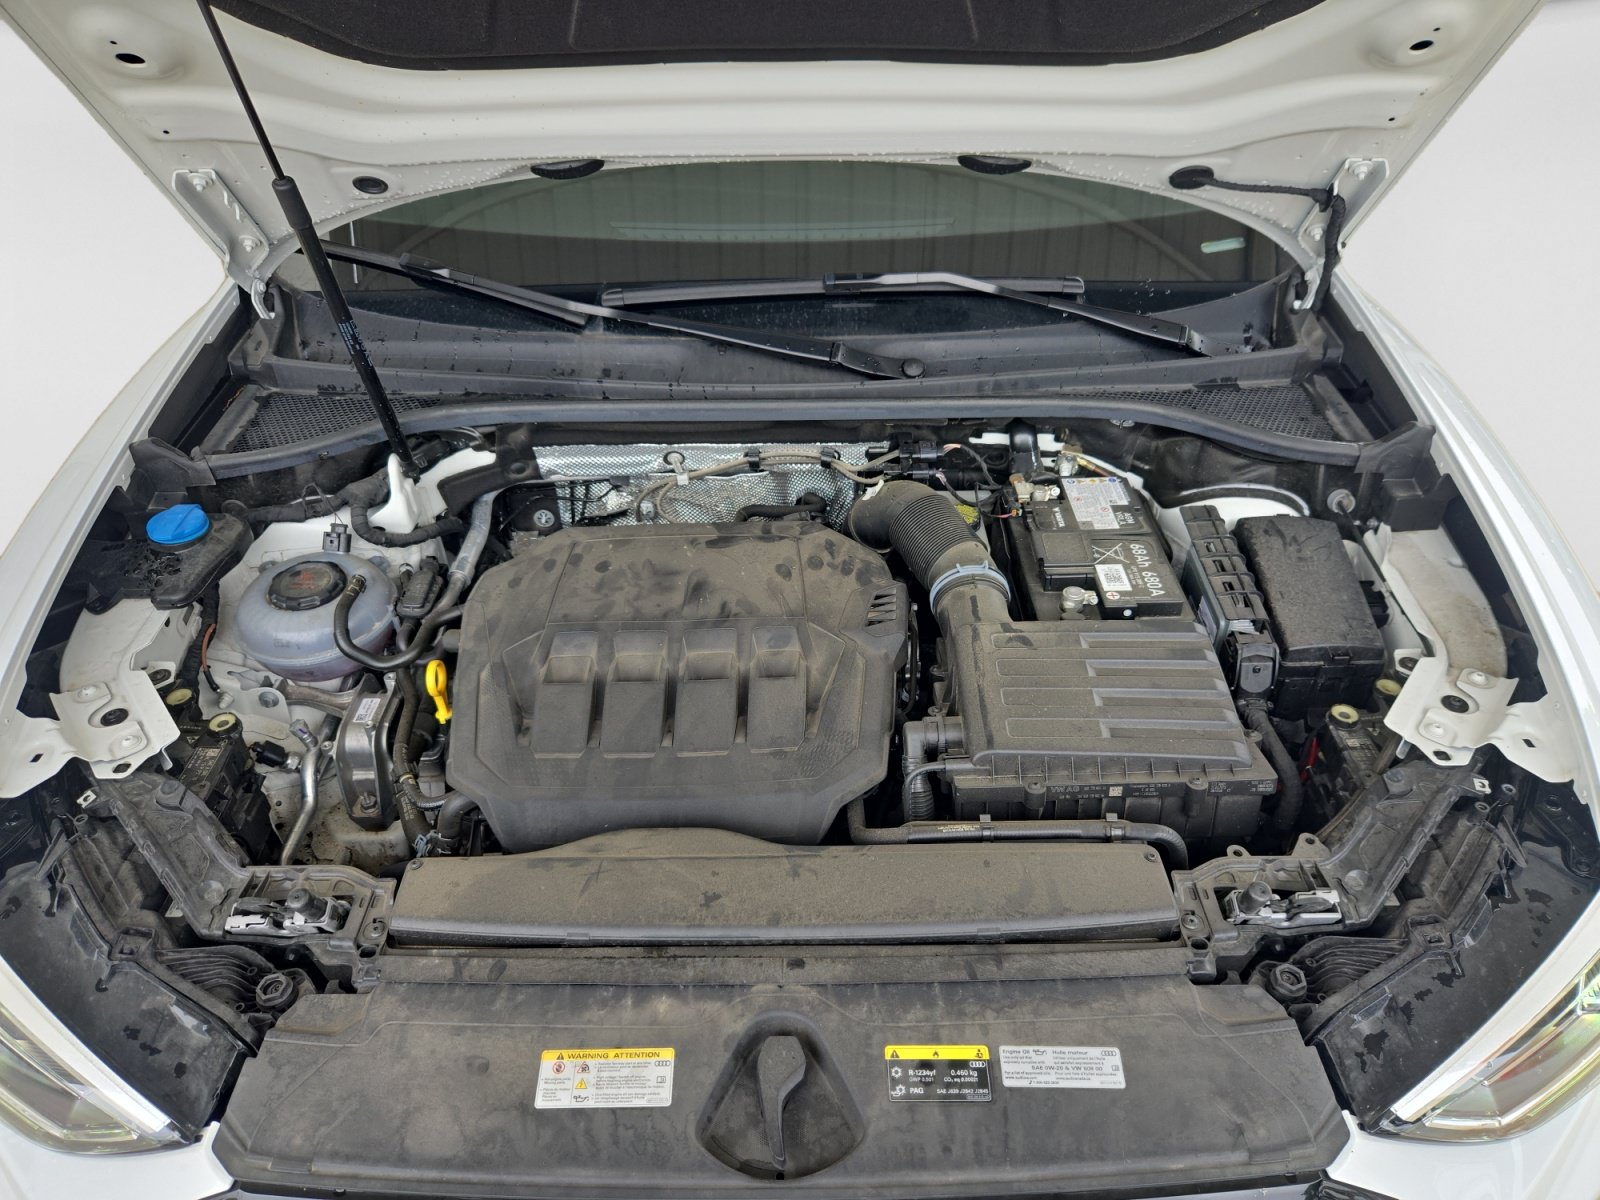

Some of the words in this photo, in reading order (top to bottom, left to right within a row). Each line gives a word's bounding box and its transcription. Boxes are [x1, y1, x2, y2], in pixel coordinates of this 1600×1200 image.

[1130, 543, 1152, 568] 68Ah
[1141, 571, 1166, 597] 680A
[567, 1052, 609, 1060] WARNING
[613, 1051, 661, 1059] ATTENTION
[908, 1069, 936, 1077] R-1234yf
[969, 1069, 978, 1077] kg
